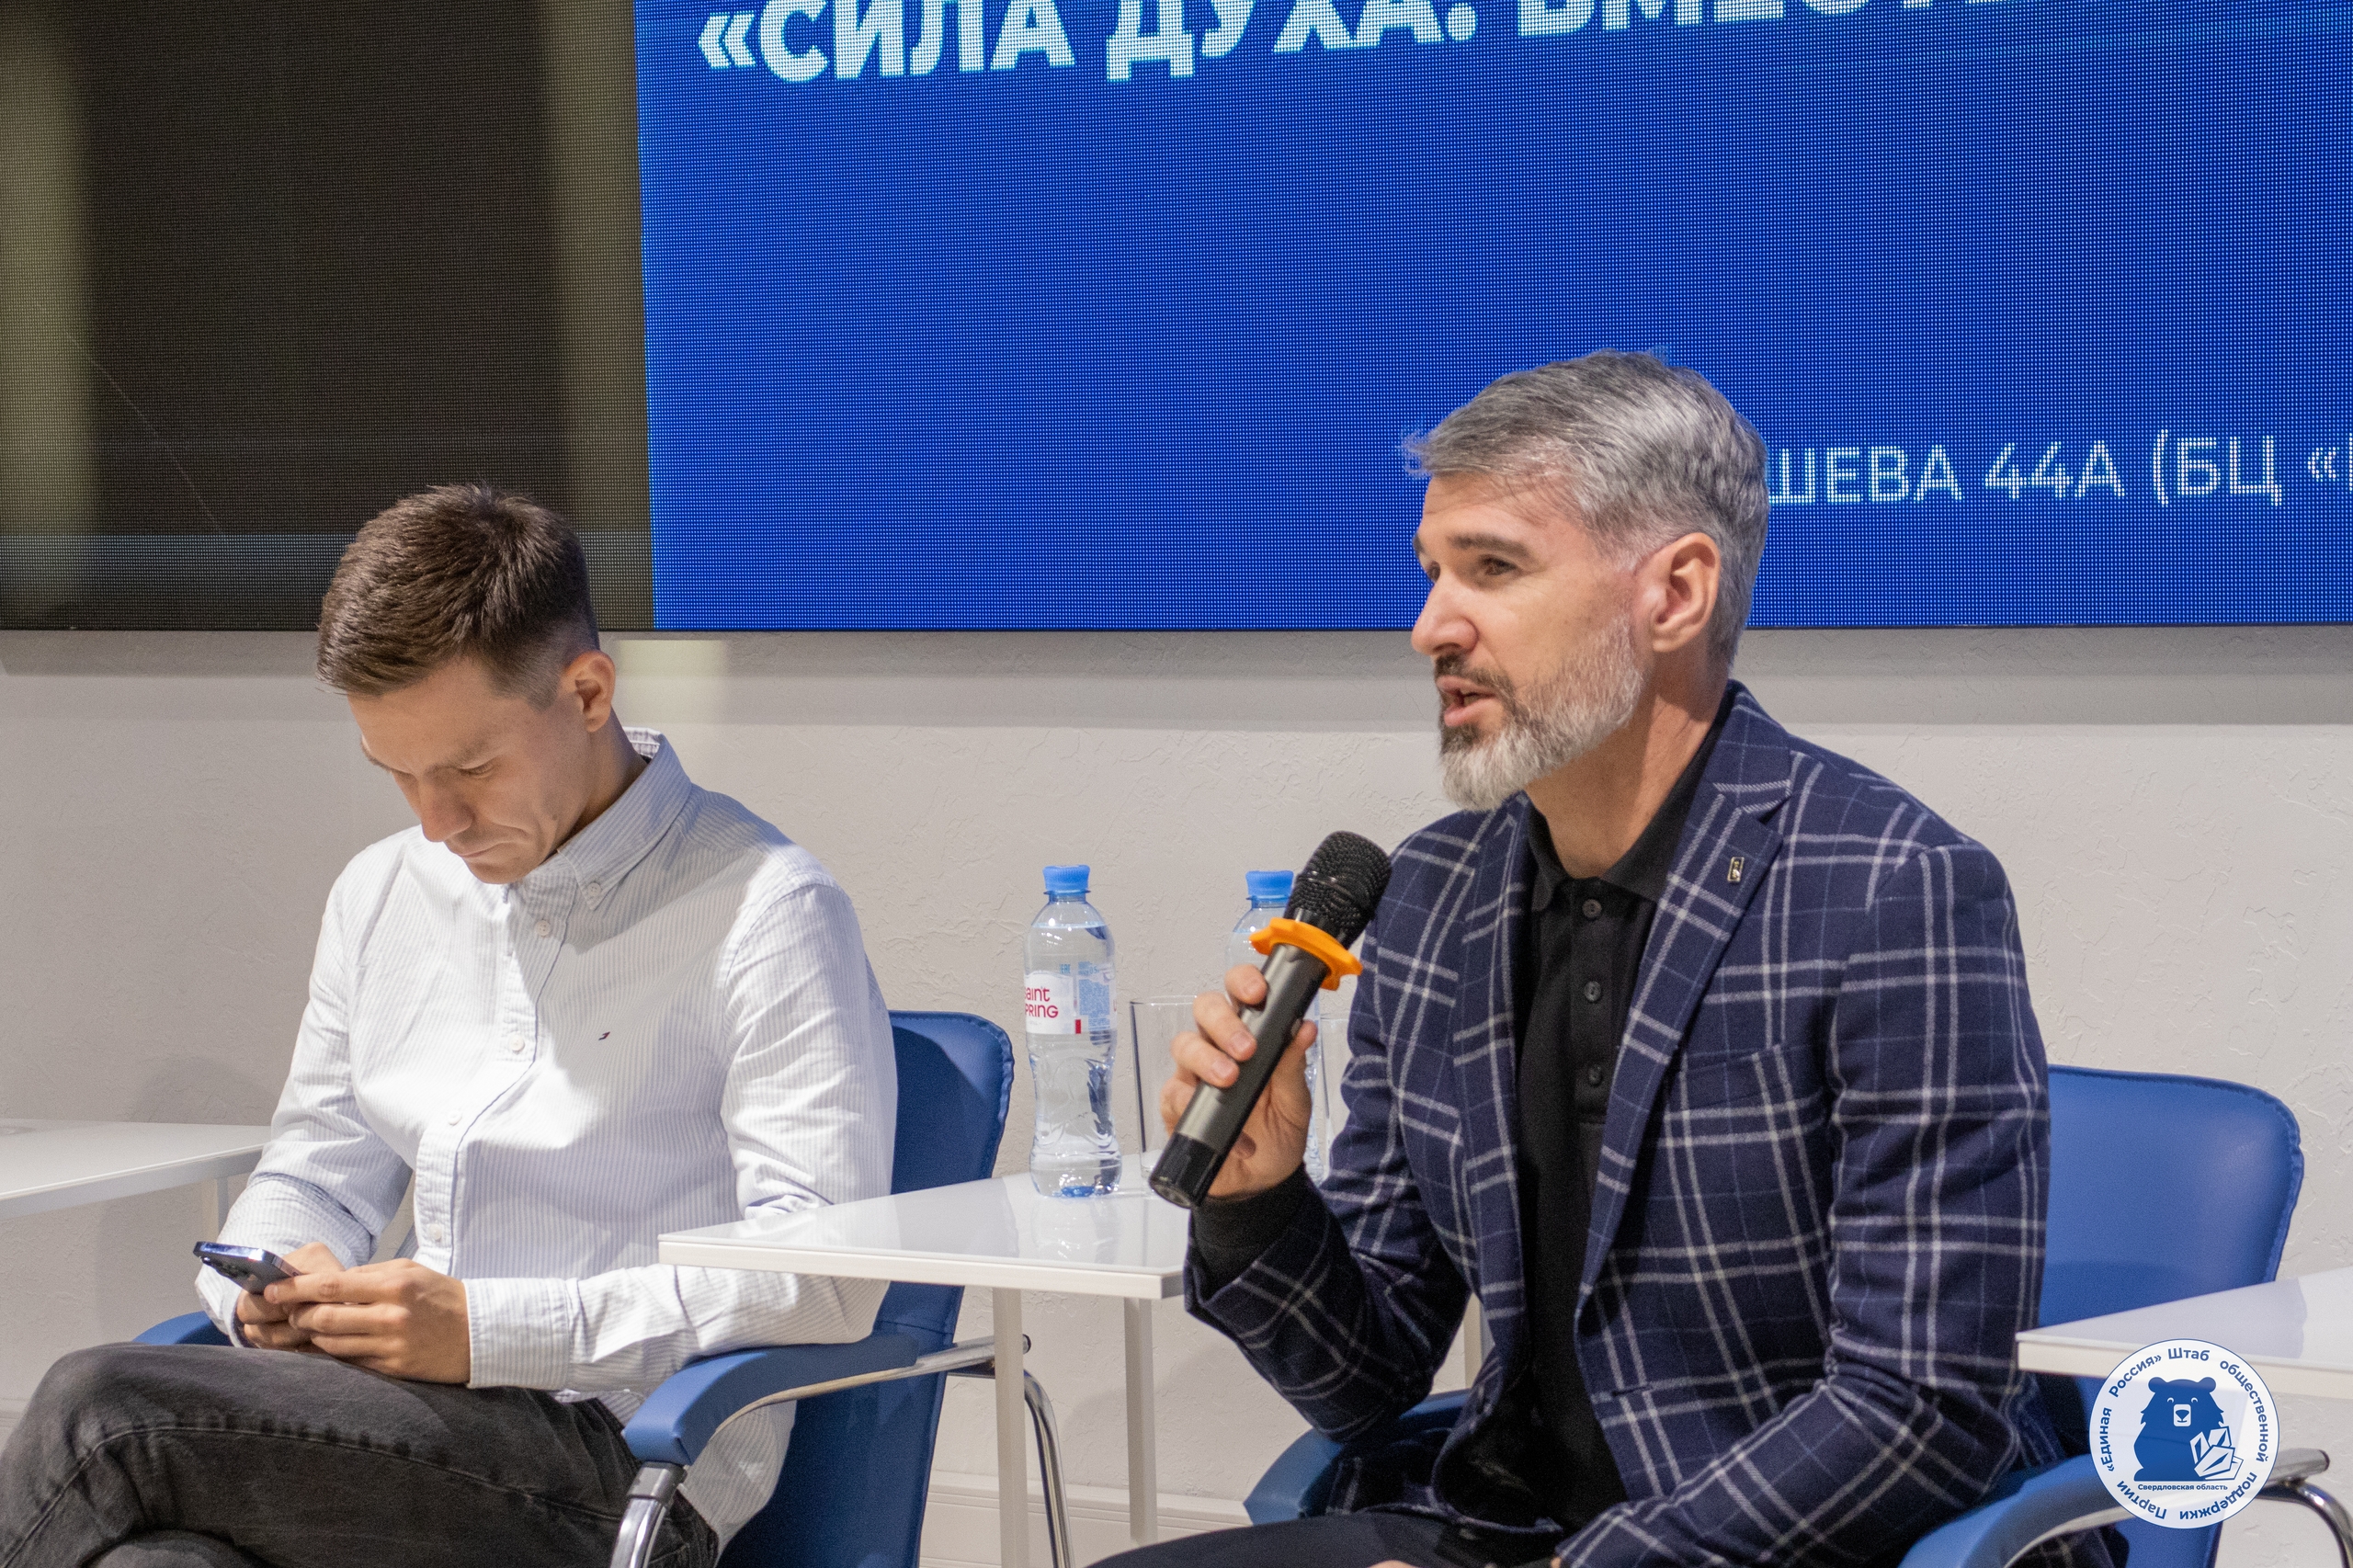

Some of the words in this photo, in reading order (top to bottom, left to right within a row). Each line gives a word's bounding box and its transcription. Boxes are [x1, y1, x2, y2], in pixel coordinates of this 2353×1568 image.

[697, 0, 1076, 83] «СИЛА
[1984, 439, 2126, 501] 44А
[2152, 428, 2282, 506] (БЦ
[1025, 987, 1051, 1003] aint
